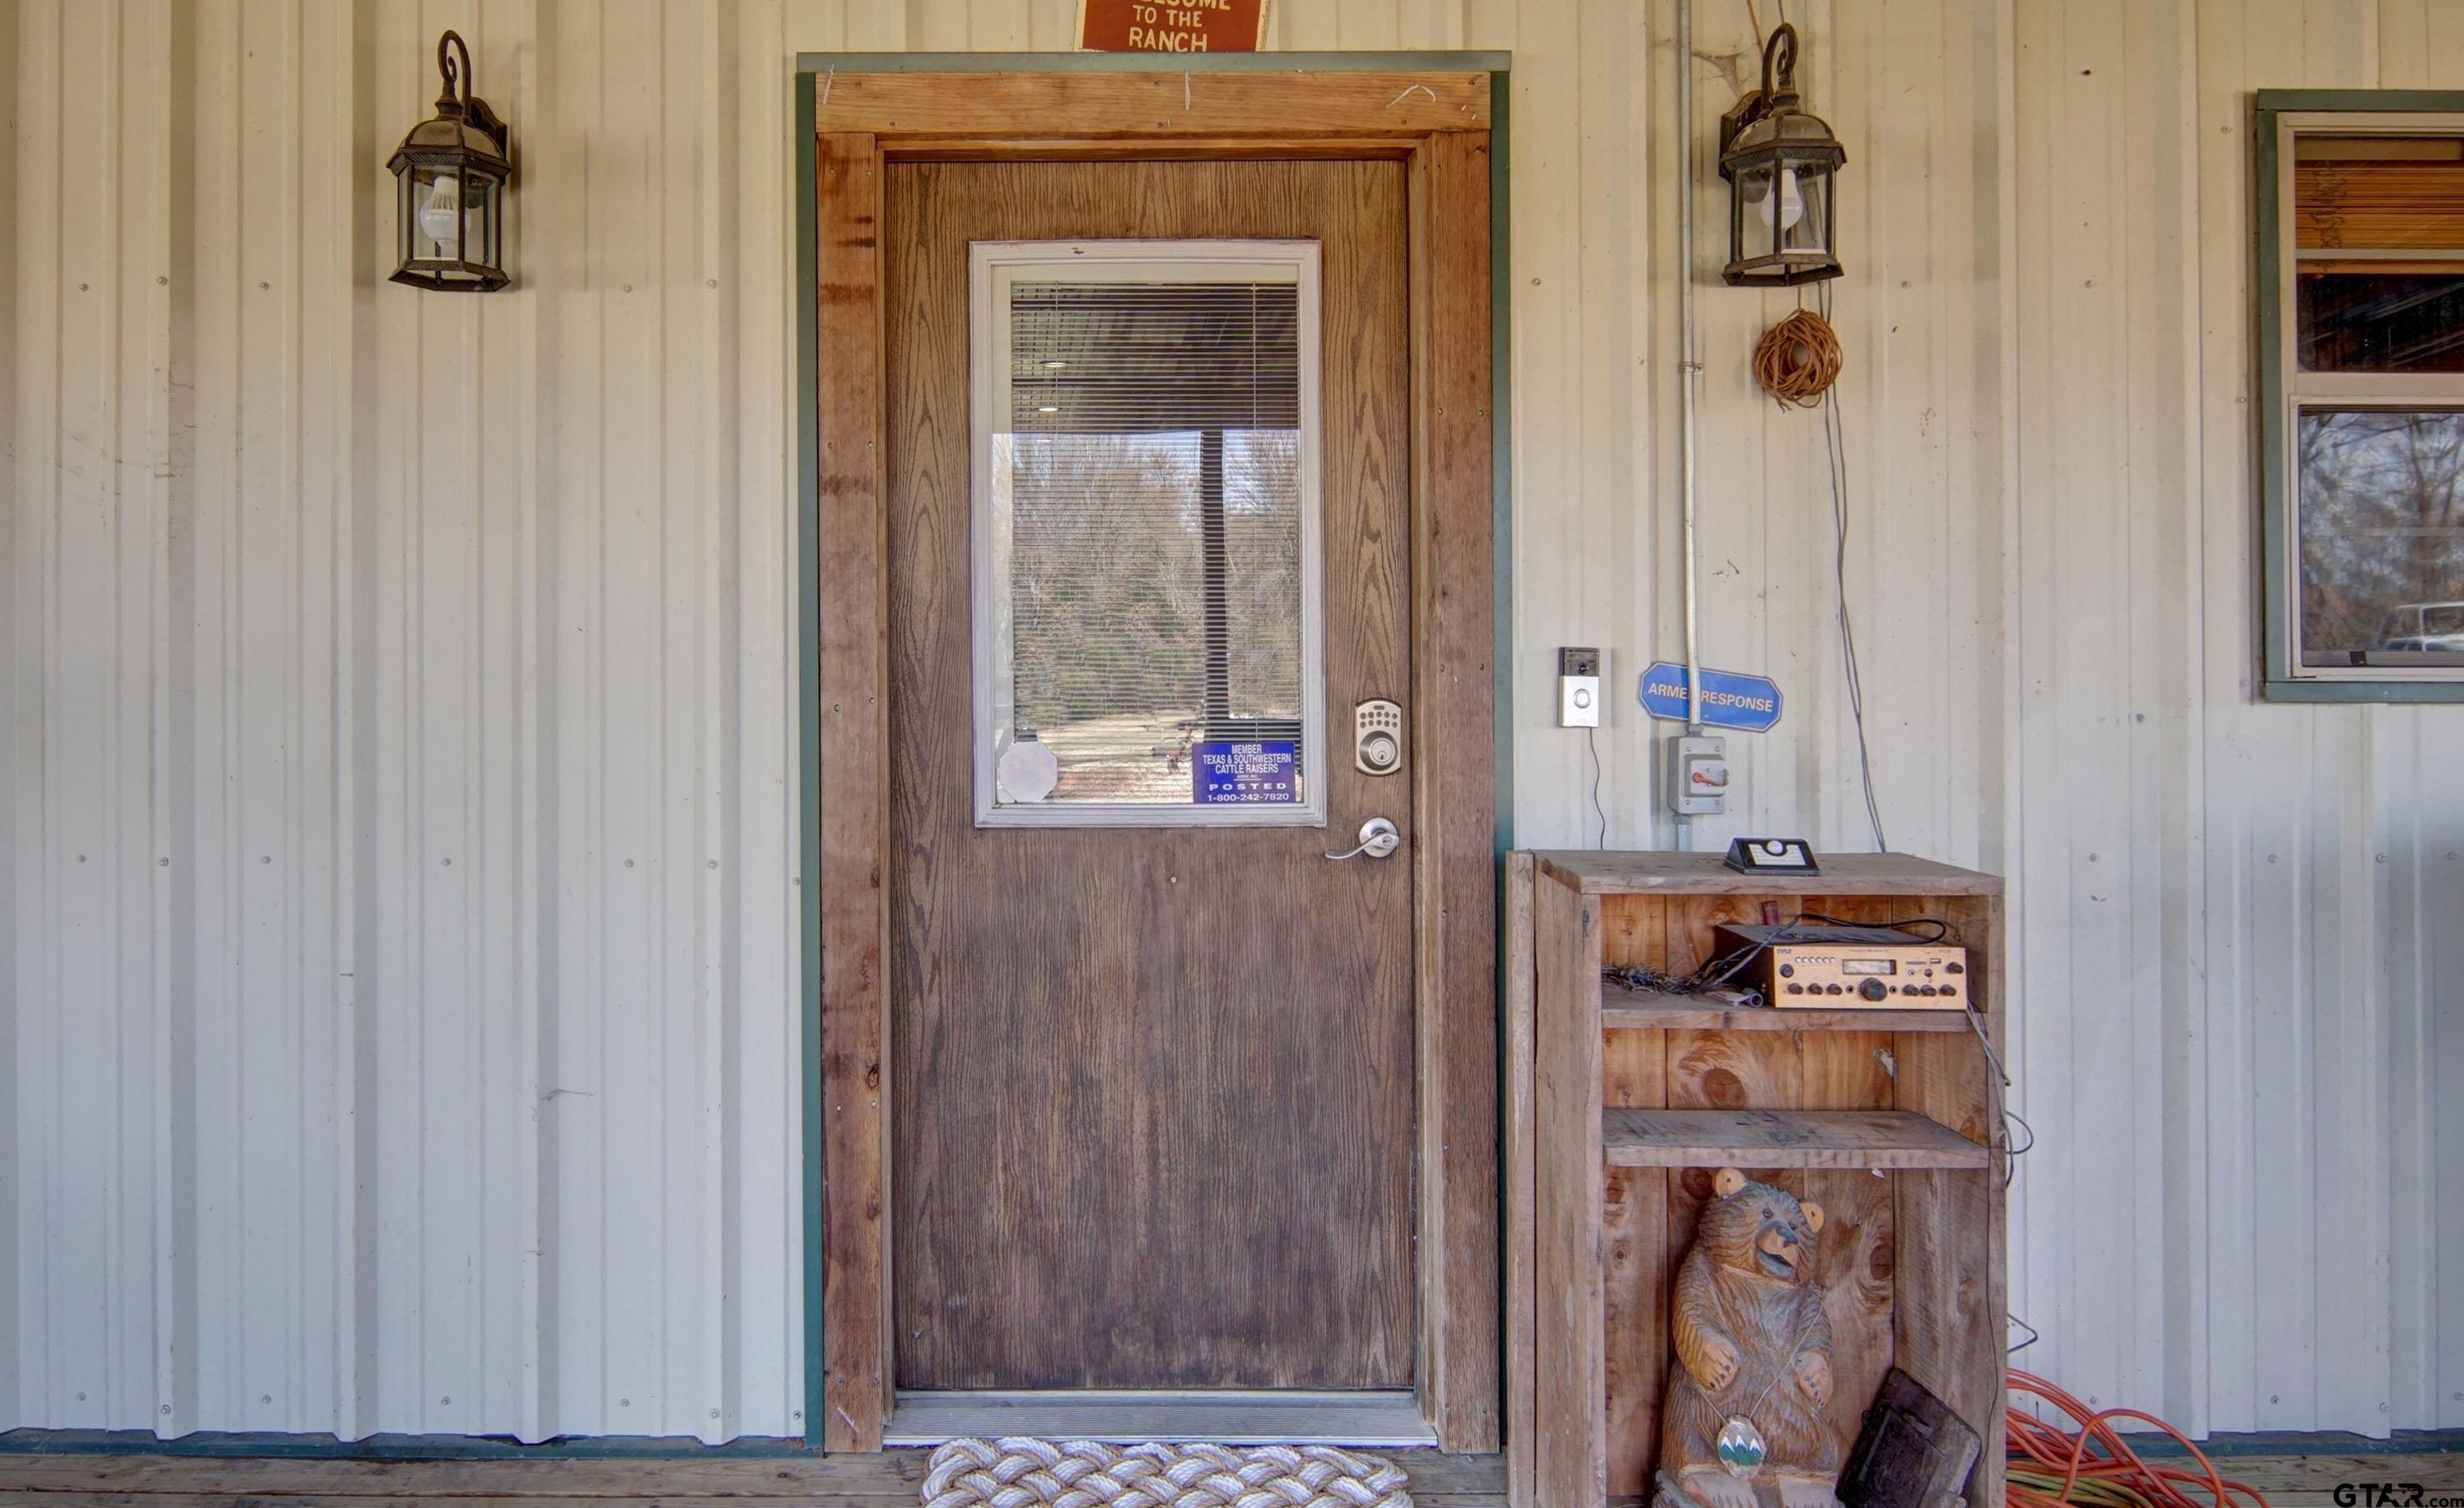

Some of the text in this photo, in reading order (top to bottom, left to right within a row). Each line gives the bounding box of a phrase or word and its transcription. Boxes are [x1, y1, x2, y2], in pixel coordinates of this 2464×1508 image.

[1132, 4, 1157, 24] TO
[1166, 9, 1203, 27] THE
[1129, 25, 1207, 52] RANCH
[1648, 683, 1773, 712] ARME RESPONSE
[1231, 744, 1262, 754] MEMBER
[1202, 753, 1292, 765] TEXAS & SOUTHWESTERN
[1215, 763, 1279, 774] CATTLE RAISERS
[1209, 783, 1287, 791] POSTED
[1207, 793, 1289, 802] 1-800-242-7820
